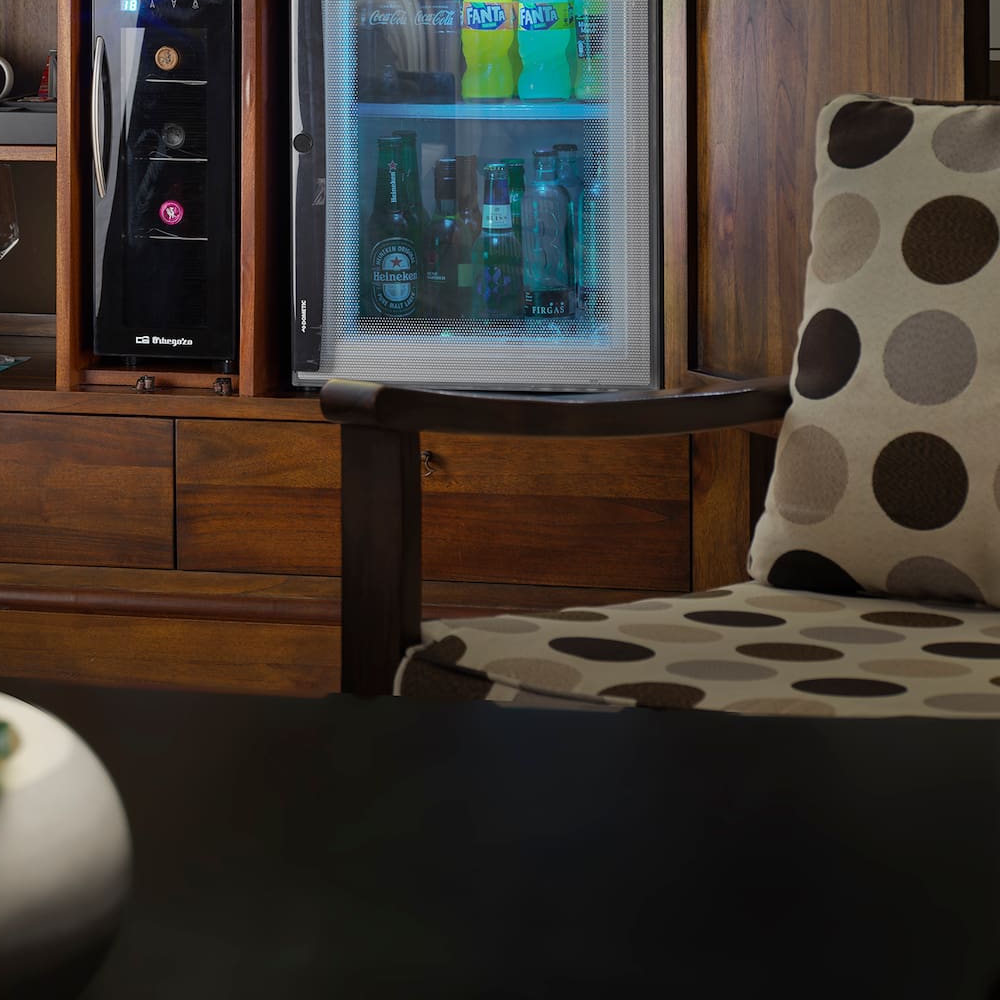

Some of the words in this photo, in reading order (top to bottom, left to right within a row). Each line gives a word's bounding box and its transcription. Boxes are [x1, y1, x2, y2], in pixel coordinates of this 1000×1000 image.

[124, 0, 137, 11] 18
[466, 4, 506, 25] FANTA
[519, 4, 558, 26] FANTA
[373, 271, 418, 282] Heineken
